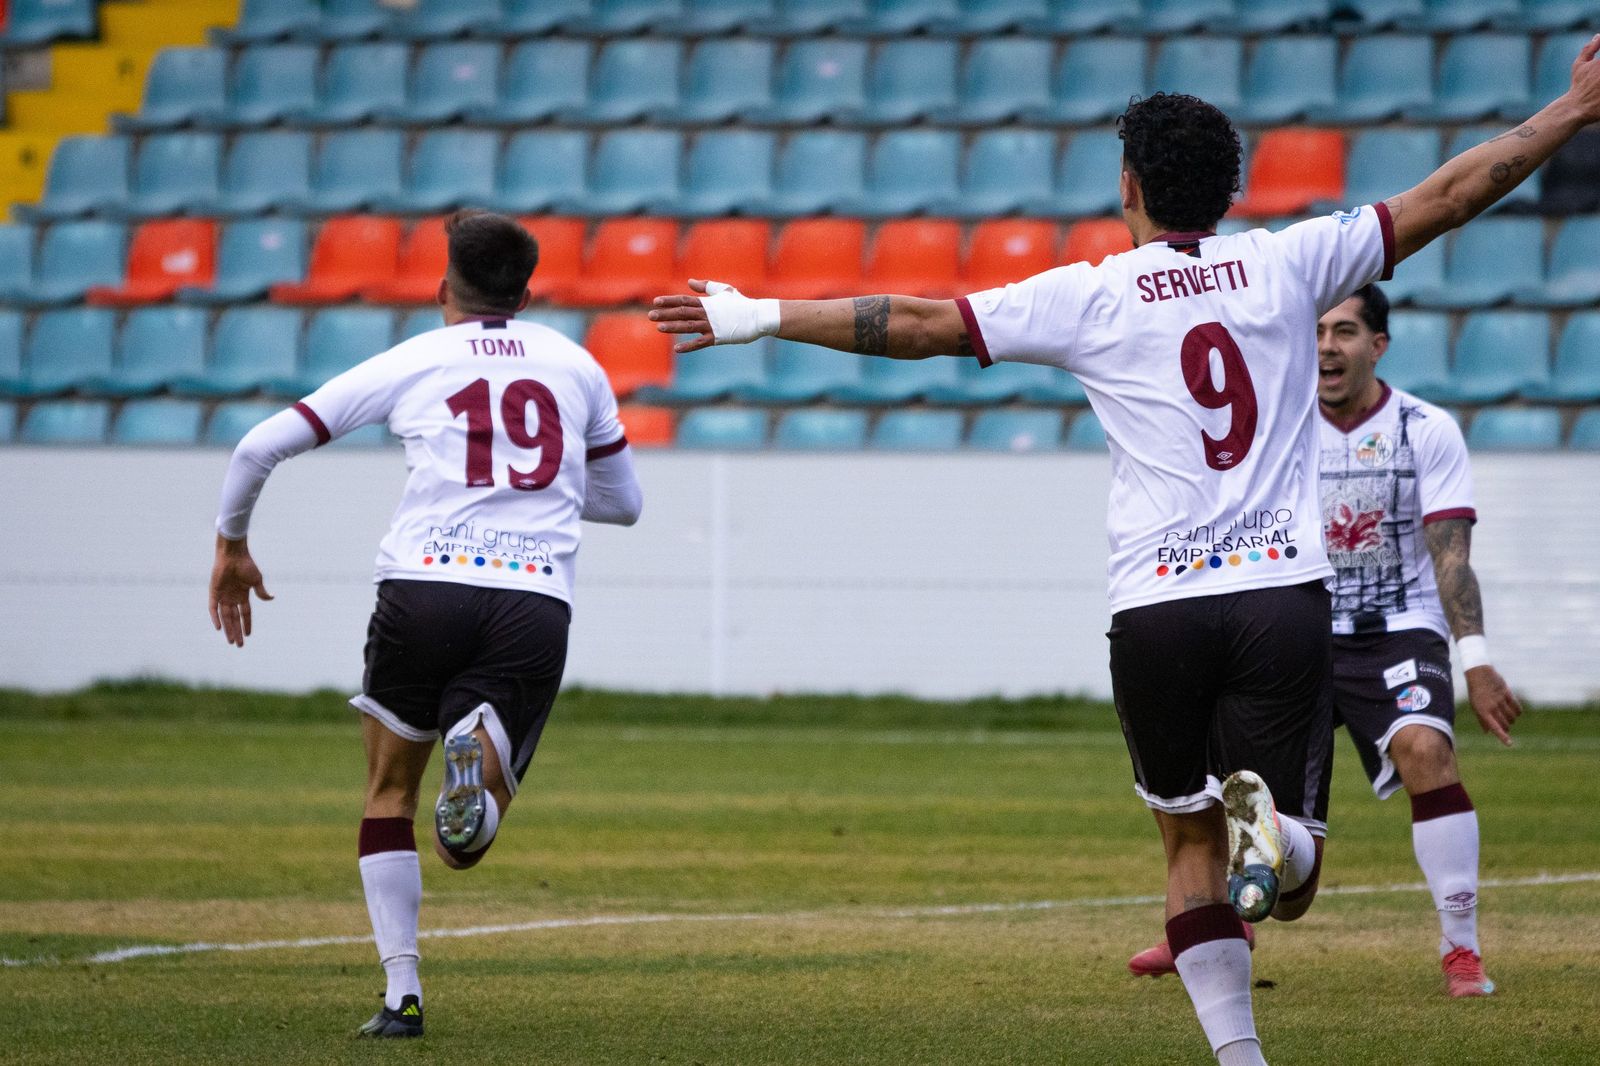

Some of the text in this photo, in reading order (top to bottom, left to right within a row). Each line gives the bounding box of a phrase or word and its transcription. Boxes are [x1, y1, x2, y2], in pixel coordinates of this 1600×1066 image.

[1136, 259, 1249, 303] SERVETTI
[465, 338, 526, 357] TOMI
[1180, 321, 1258, 471] 9
[445, 377, 564, 491] 19
[483, 528, 552, 553] grupo
[1218, 508, 1293, 540] upo
[1157, 529, 1296, 563] EMPESARIAL
